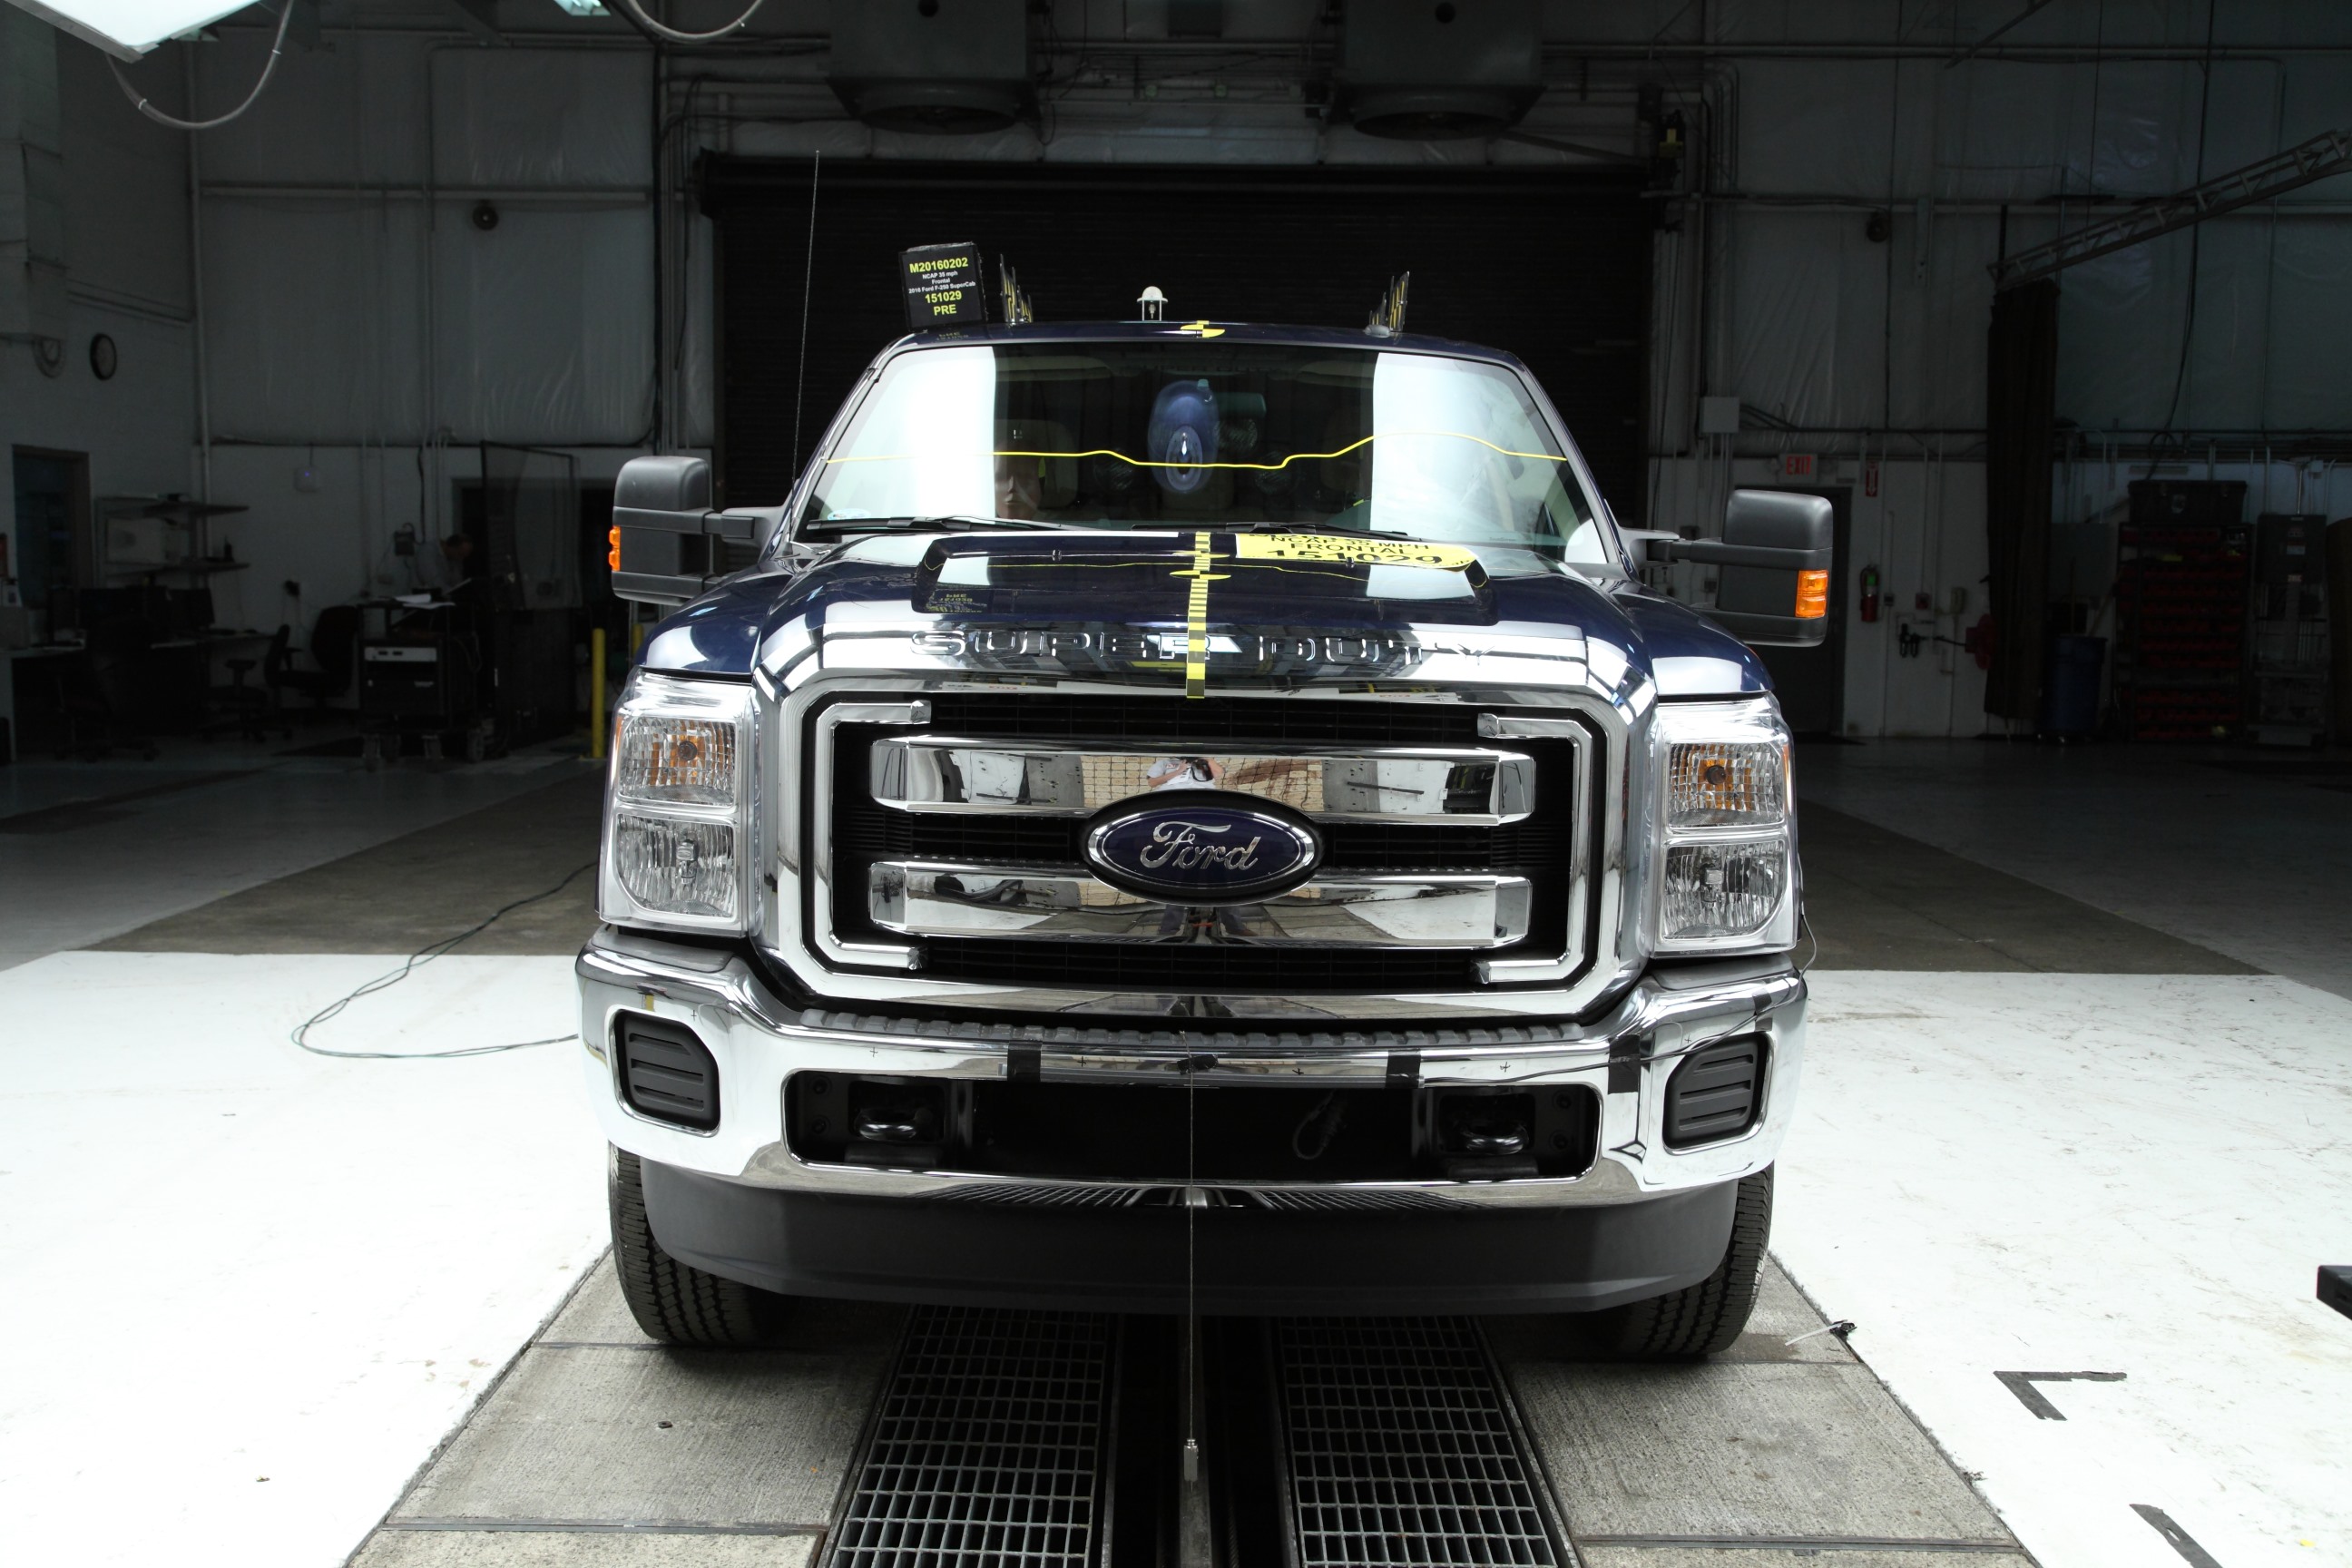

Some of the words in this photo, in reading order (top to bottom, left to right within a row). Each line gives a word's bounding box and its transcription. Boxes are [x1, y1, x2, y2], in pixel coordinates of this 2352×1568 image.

[909, 257, 969, 273] M20160202
[949, 280, 976, 289] SuperCab
[925, 290, 962, 304] 151029
[933, 304, 957, 316] PRE
[1786, 456, 1812, 475] EXIT
[1290, 543, 1413, 556] FRONTAL
[1378, 542, 1429, 550] MPH
[1268, 549, 1443, 564] 151029
[1140, 821, 1261, 870] Ford
